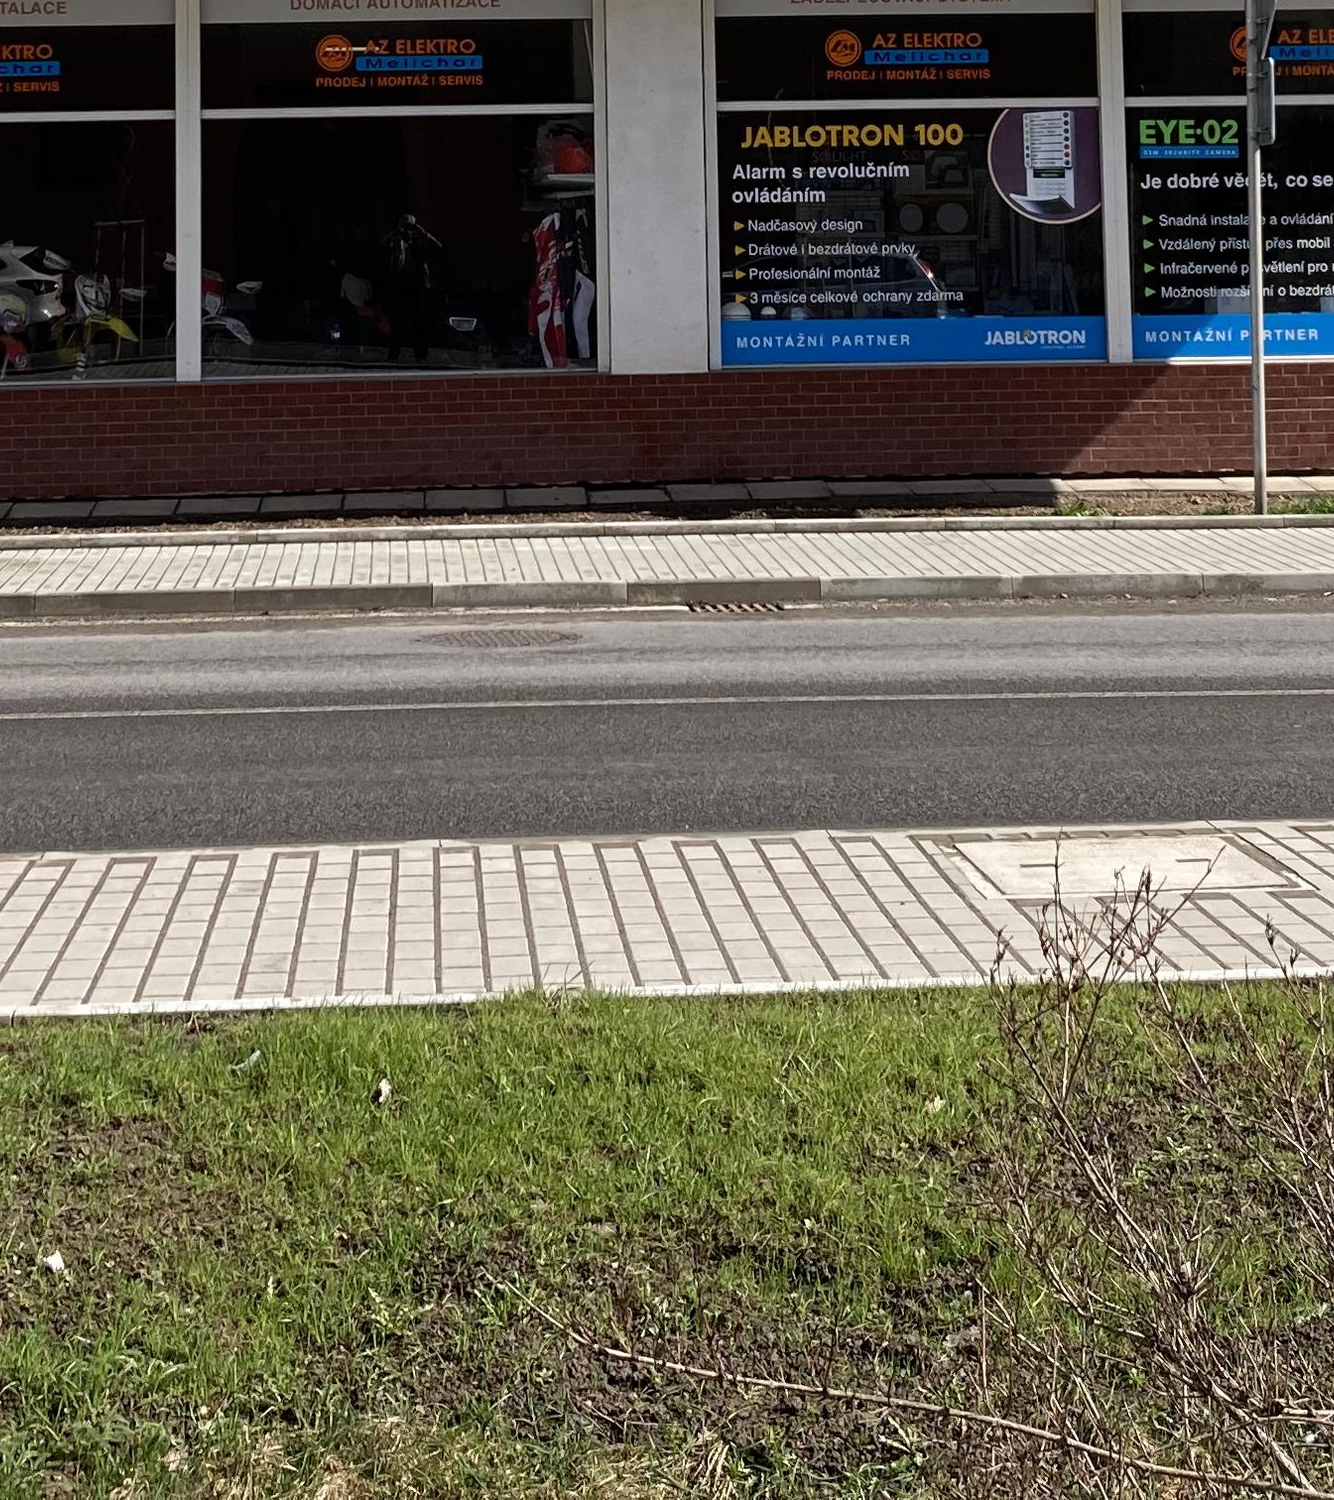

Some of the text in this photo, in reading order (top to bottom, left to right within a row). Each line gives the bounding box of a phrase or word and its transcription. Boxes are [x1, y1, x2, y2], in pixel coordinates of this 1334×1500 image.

[872, 33, 898, 48] AZ
[903, 32, 983, 48] ELEKTRO
[1277, 29, 1303, 44] AZ
[364, 39, 390, 55] AZ
[395, 38, 476, 54] ELEKTRO
[366, 58, 477, 69] Melichar
[873, 51, 983, 62] Melichar
[315, 72, 484, 88] PRODEJ MONTÁŽ SERVIS
[827, 66, 991, 81] PRODEJ MONTÁŽ SERVIS
[13, 81, 60, 93] SERVIS
[740, 123, 964, 148] JABLOTRON 100
[732, 161, 910, 180] Alarm s revolučním
[1140, 174, 1162, 190] Je
[1167, 172, 1220, 189] dobré
[1285, 175, 1308, 188] co
[1312, 174, 1334, 187] se
[732, 187, 826, 204] ovládáním
[747, 219, 864, 234] Nadčasový design
[1158, 214, 1207, 227] Snadná
[1269, 216, 1278, 225] a
[1280, 213, 1334, 226] ovládání
[748, 243, 798, 257] Drátové
[808, 242, 878, 256] bezdrátové
[881, 244, 916, 258] prvky
[1158, 238, 1216, 252] Vzdálený
[1265, 237, 1293, 252] přes
[1296, 237, 1331, 249] mobil
[748, 266, 881, 280] Profesionální montáž
[1159, 261, 1238, 274] Infračervené
[1307, 262, 1328, 275] pro
[749, 290, 964, 306] 3 měsíce celkové ochrany zdarma
[1160, 285, 1217, 299] Možnosti
[1277, 286, 1286, 296] o
[736, 333, 910, 348] MONTÁŽNÍ PARTNER
[984, 329, 1086, 345] JABLOTRON
[1145, 327, 1319, 342] MONTÁŽNÍ PRTNER
